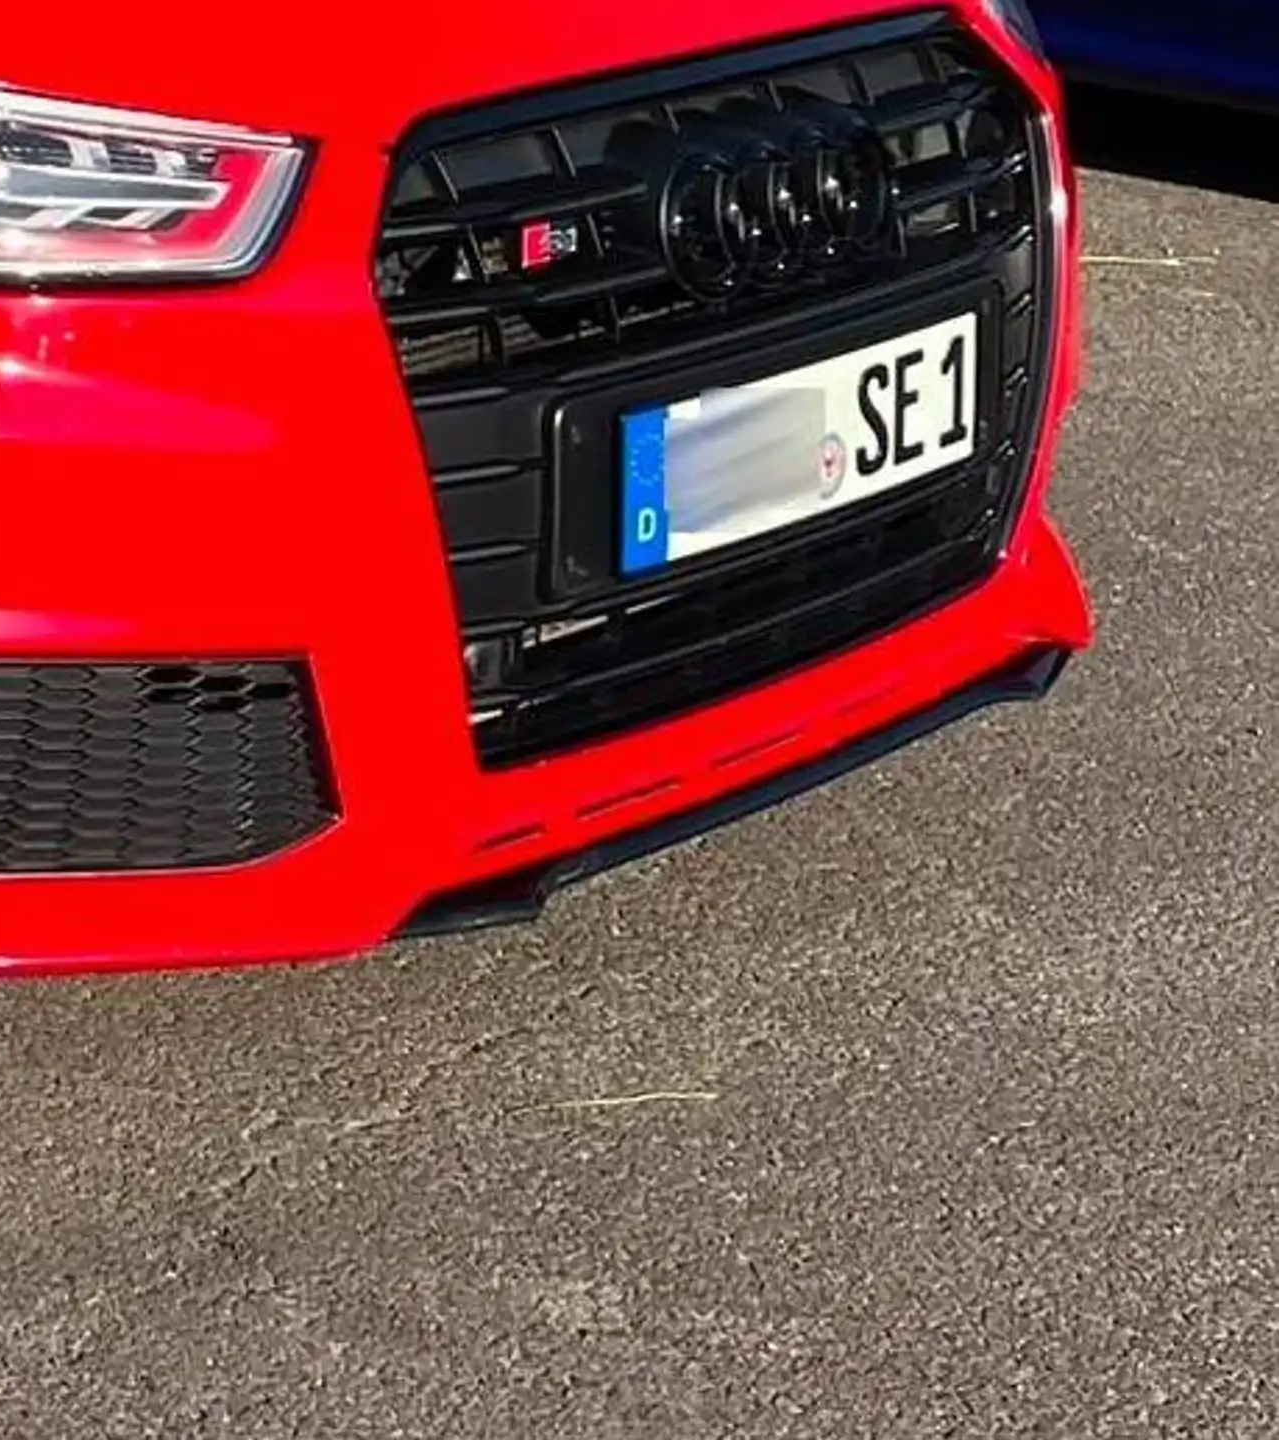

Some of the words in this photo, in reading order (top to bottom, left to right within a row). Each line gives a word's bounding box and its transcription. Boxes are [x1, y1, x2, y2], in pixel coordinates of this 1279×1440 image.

[856, 349, 923, 477] SE
[940, 334, 967, 448] 1
[637, 507, 657, 544] D
